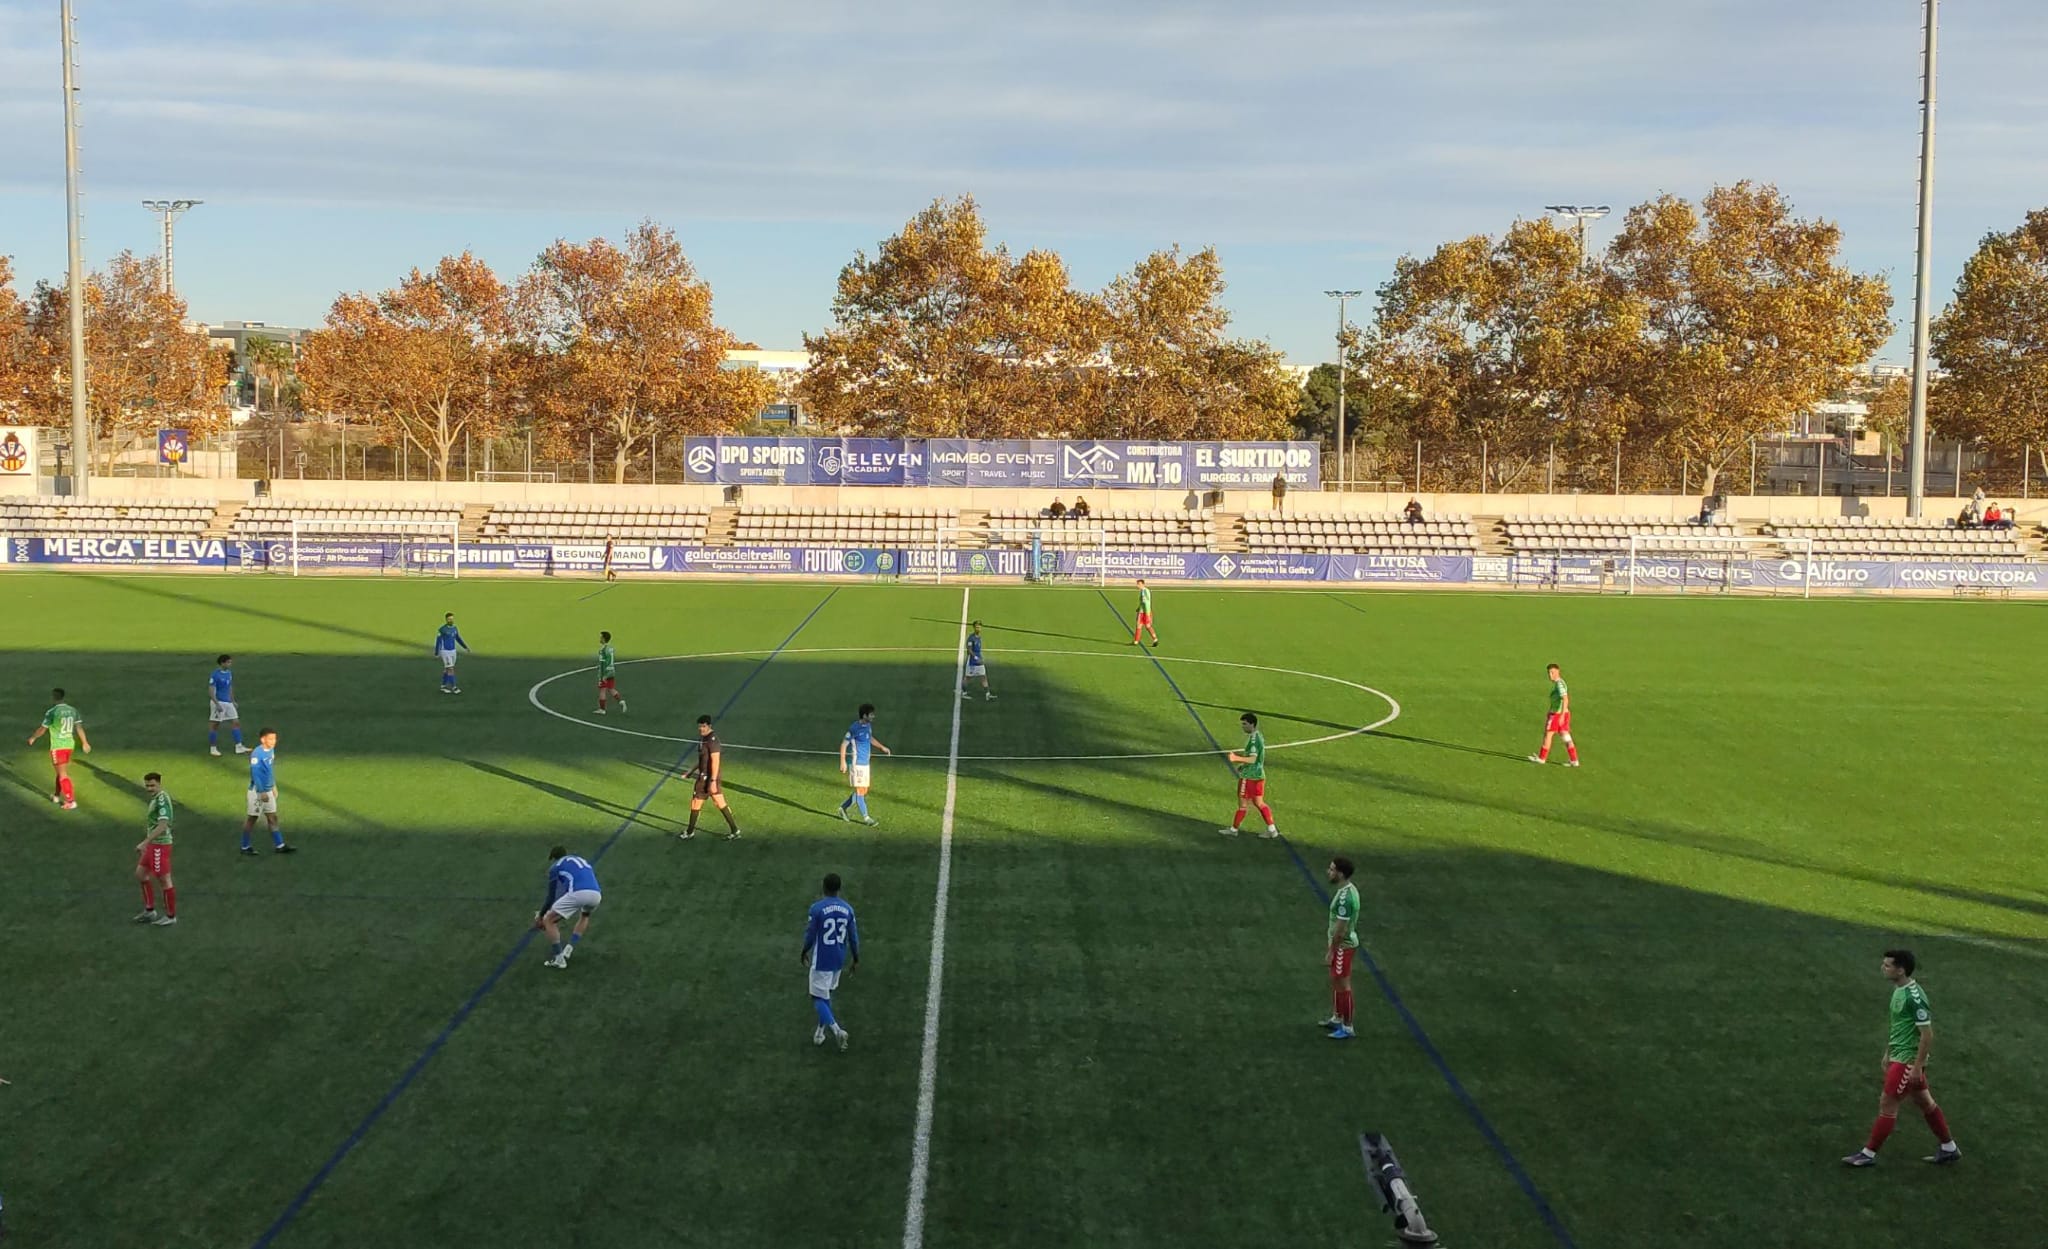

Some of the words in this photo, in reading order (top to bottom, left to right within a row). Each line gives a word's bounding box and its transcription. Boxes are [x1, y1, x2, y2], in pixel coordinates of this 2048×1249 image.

[721, 446, 749, 464] DPO
[752, 446, 805, 465] SPORTS
[1126, 445, 1183, 456] CONSTRUCTORA
[847, 453, 923, 466] ELEVEN
[932, 452, 991, 464] MAMBO
[996, 453, 1055, 465] EVENTS
[1196, 448, 1216, 467] EL
[1218, 448, 1312, 468] SURTIDOR
[740, 468, 762, 476] SPORTS
[763, 468, 786, 477] AGENCY
[1100, 460, 1114, 472] 10
[1126, 462, 1182, 483] MX-10
[941, 469, 966, 477] SPORT
[979, 470, 1008, 478] TRAVEL
[1020, 470, 1046, 478] MUSIC
[1200, 472, 1241, 483] BURGERS
[1243, 473, 1250, 483] &
[1251, 473, 1308, 483] FRANURTS
[43, 538, 136, 557] MERCA
[144, 539, 225, 558] ELEVA
[613, 551, 646, 560] MANO
[804, 549, 843, 572] FUTUR
[1369, 556, 1428, 568] LITUSA
[1240, 565, 1274, 574] Vilanova
[1808, 561, 1869, 581] Alfaro
[1900, 568, 2038, 583] CONSTRUCTORA
[60, 716, 74, 734] 20
[823, 917, 849, 945] 23
